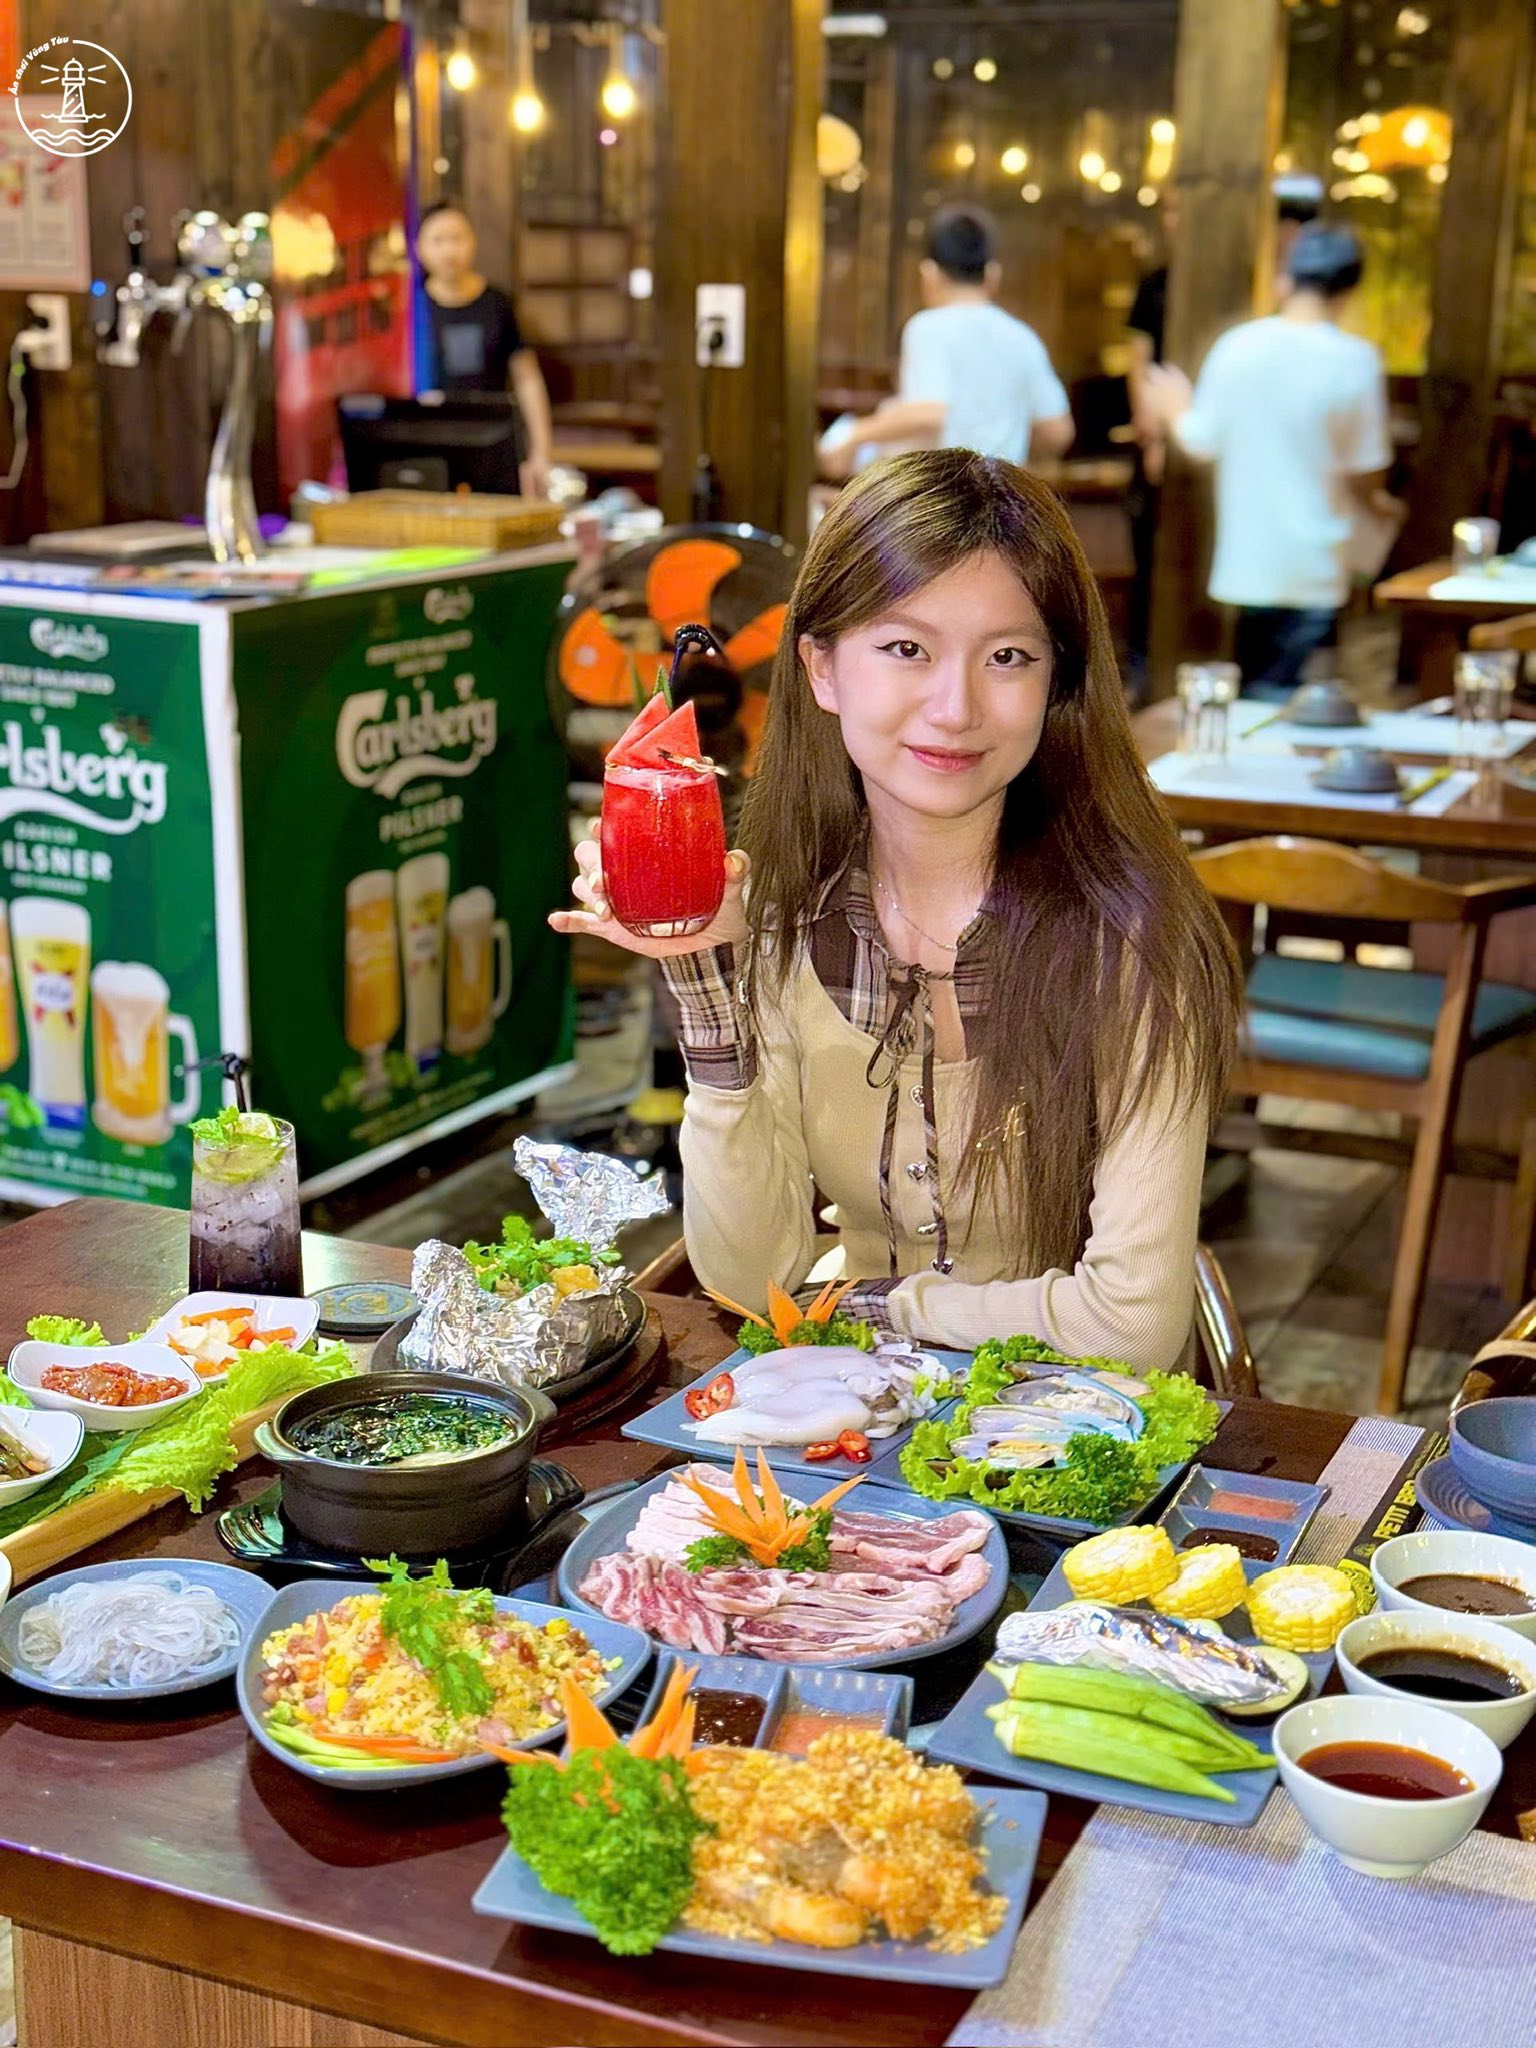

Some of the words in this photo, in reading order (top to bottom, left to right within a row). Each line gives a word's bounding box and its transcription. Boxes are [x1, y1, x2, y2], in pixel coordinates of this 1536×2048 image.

[0, 720, 168, 825] lsberg
[335, 688, 497, 796] Carlsberg
[379, 795, 463, 843] PILSNER
[1372, 1504, 1410, 1539] PETIT
